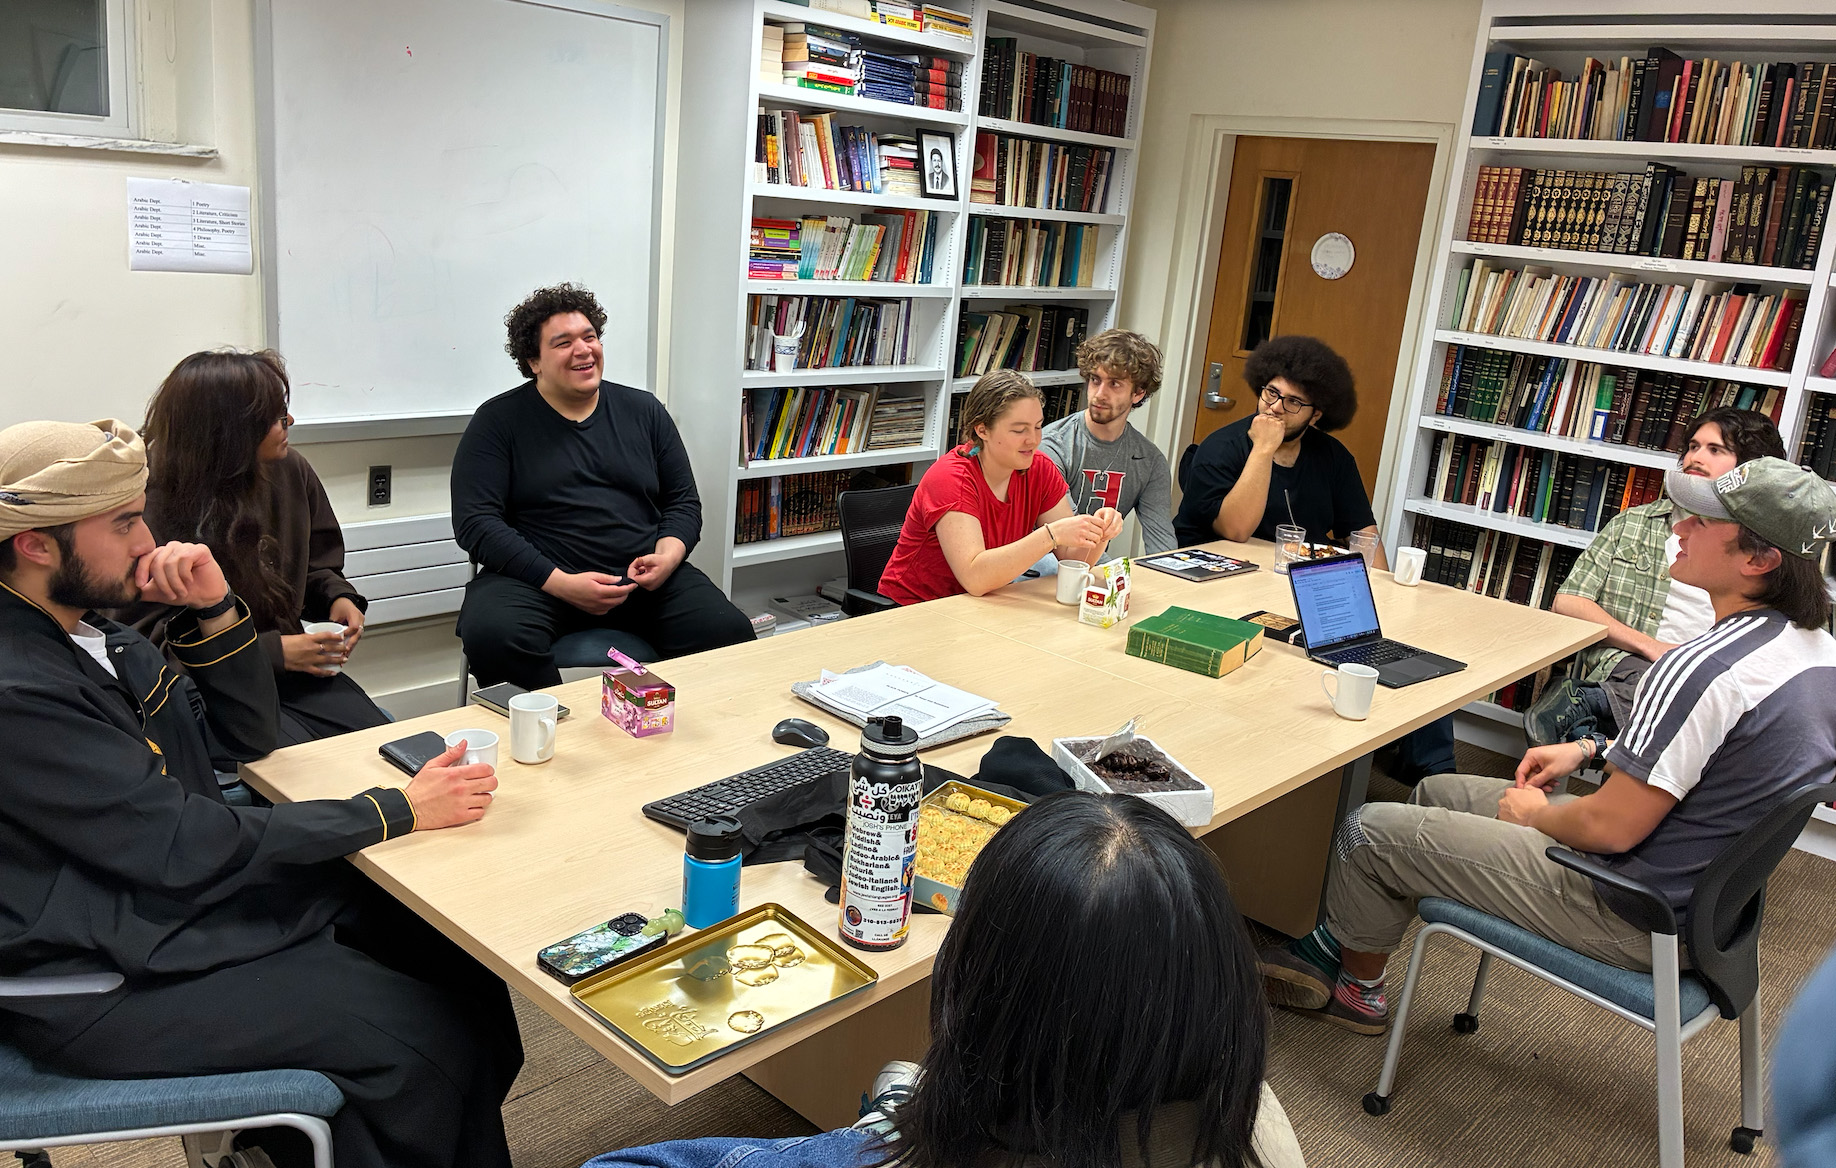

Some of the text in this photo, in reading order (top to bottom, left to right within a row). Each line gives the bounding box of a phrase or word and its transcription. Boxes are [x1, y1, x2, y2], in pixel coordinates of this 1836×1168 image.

[647, 698, 667, 706] SULTAN
[852, 825, 882, 838] Hebrew&
[852, 832, 881, 845] Yiddish&
[851, 839, 878, 853] Ladino&
[850, 847, 900, 861] Judeo-Arabic&
[848, 872, 898, 884] Judeo-Italian&
[848, 878, 869, 889] Jewish
